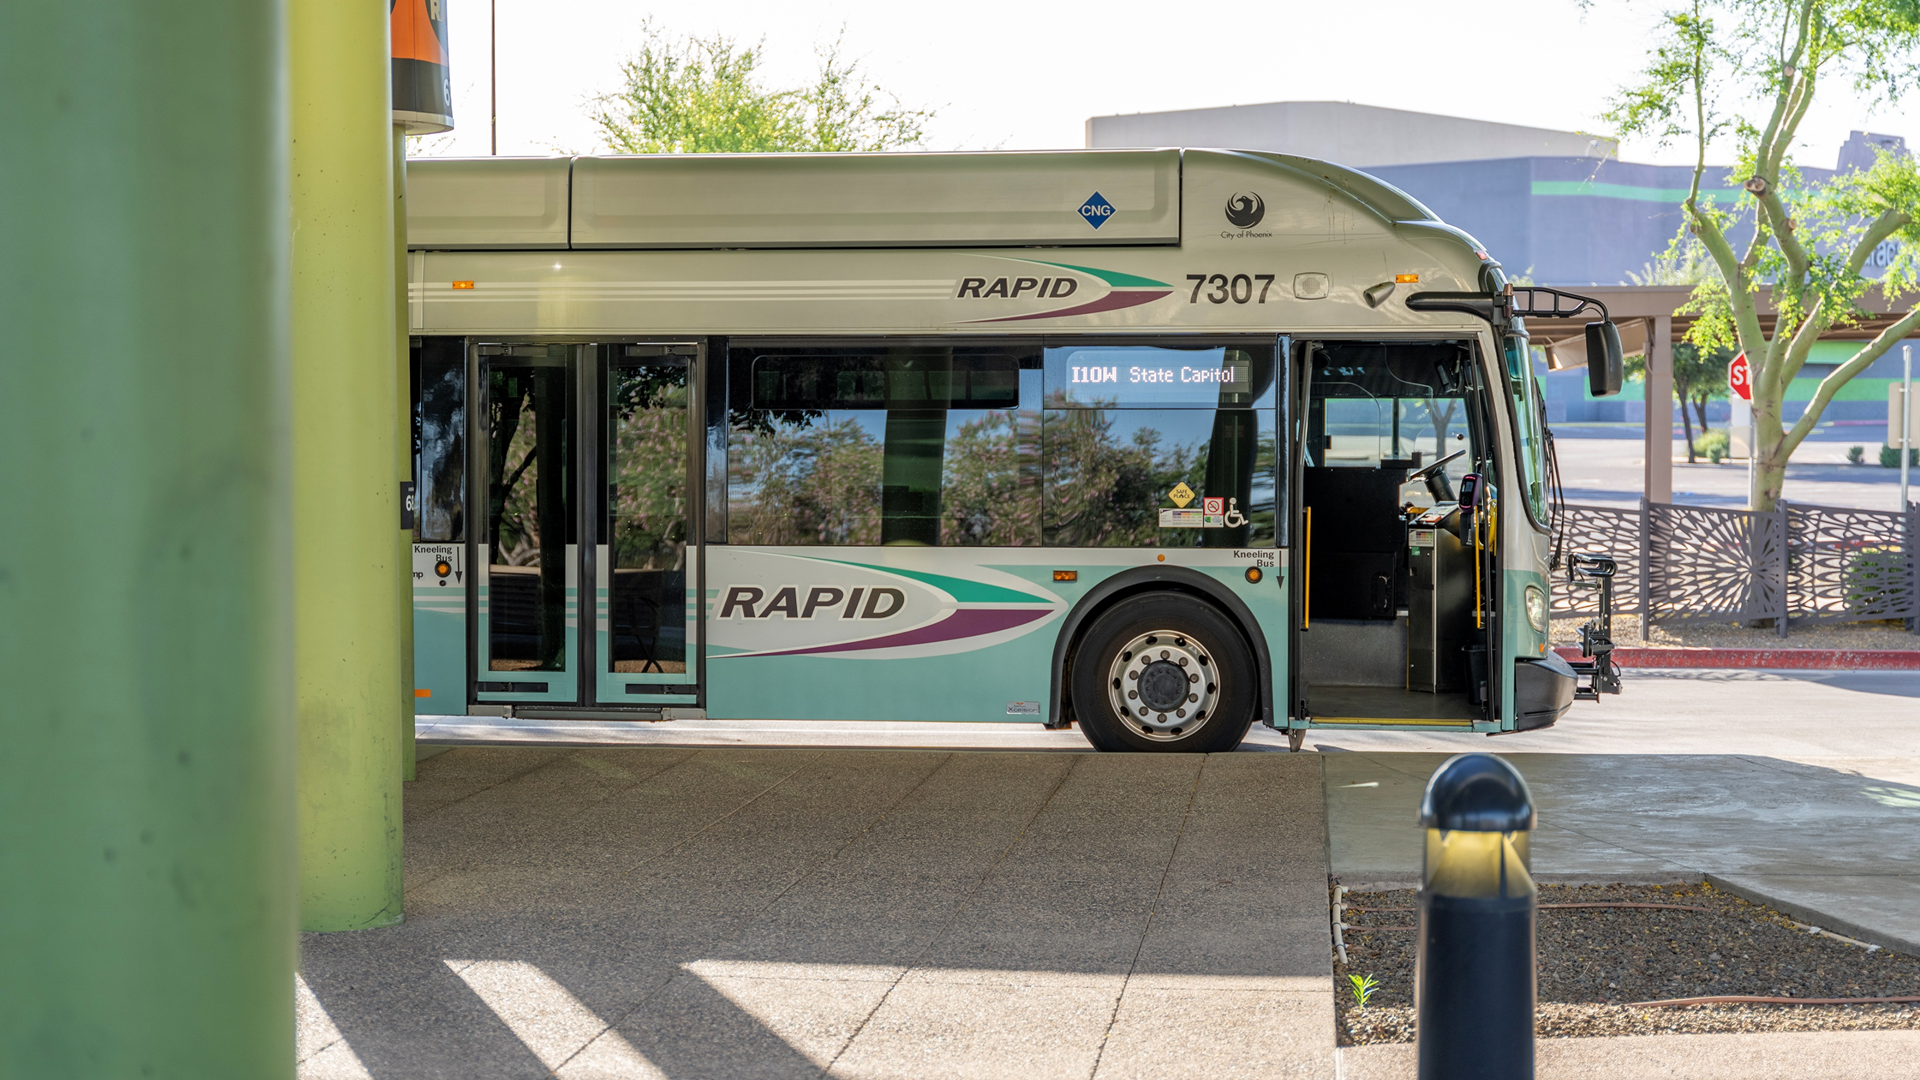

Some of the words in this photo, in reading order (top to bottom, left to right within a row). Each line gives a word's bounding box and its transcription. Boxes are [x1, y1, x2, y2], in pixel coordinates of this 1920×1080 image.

[1081, 204, 1111, 216] CNG
[1220, 230, 1235, 240] City
[1236, 230, 1245, 238] of
[1245, 230, 1273, 238] Phoenix
[957, 277, 1078, 298] RAPID
[1186, 273, 1275, 304] 7307
[1129, 366, 1174, 383] State
[1180, 366, 1234, 383] Capitol
[1732, 365, 1751, 386] ST
[414, 545, 452, 555] Kneeling
[1233, 550, 1274, 560] Kneeling
[435, 554, 452, 562] Bus
[1256, 559, 1274, 568] Bus
[719, 586, 906, 619] RAPID
